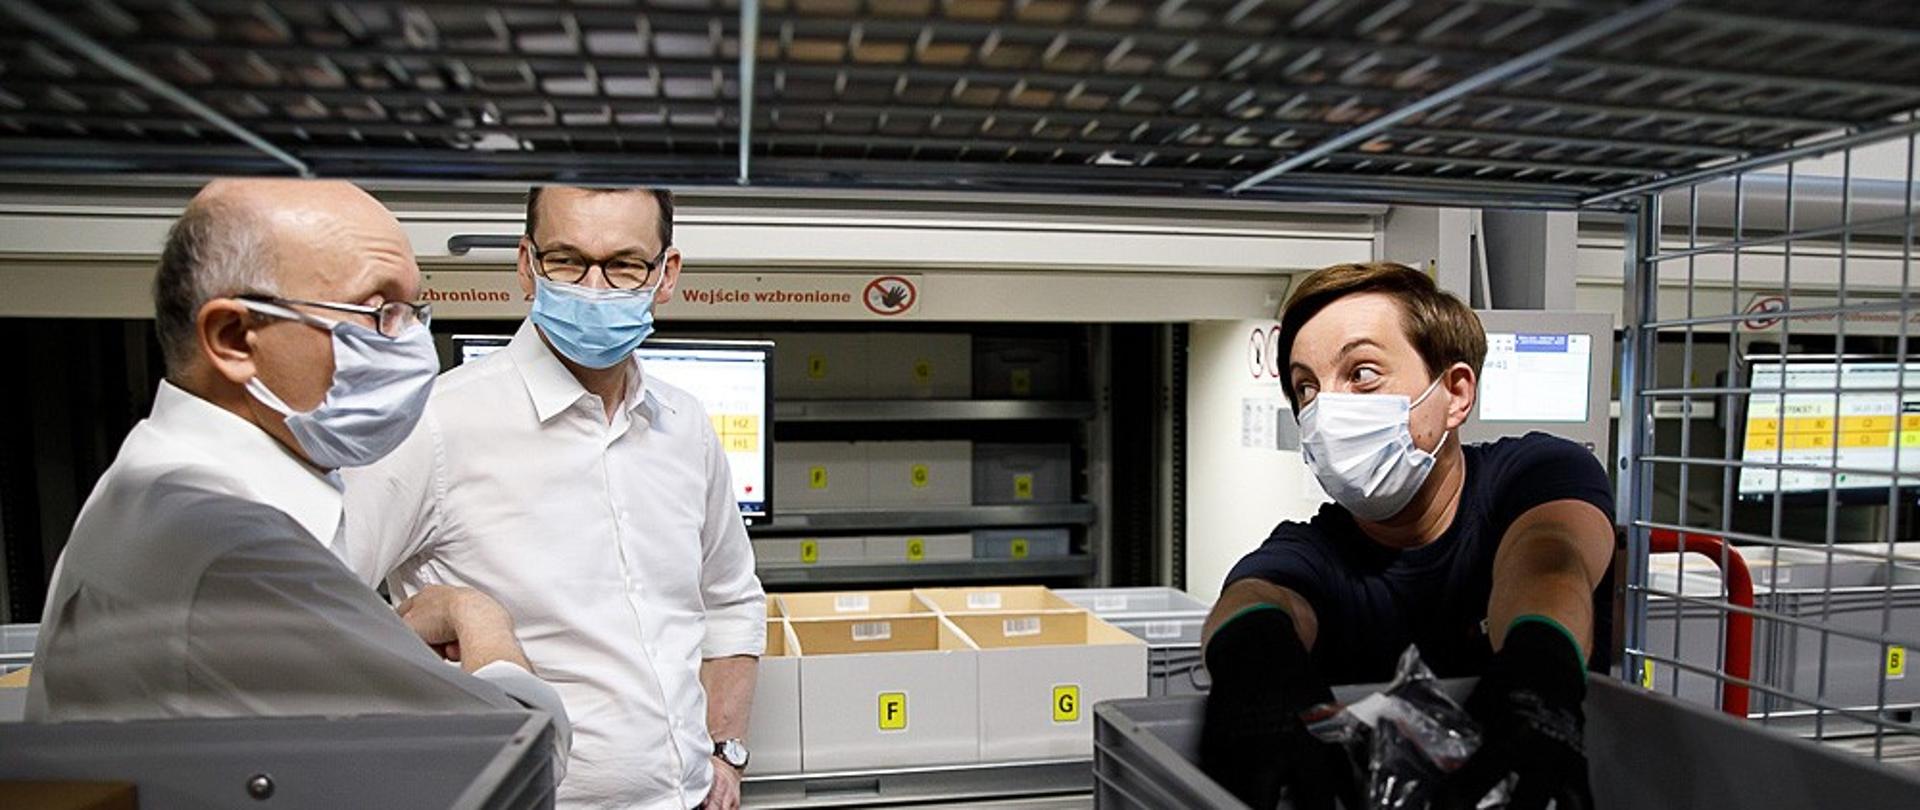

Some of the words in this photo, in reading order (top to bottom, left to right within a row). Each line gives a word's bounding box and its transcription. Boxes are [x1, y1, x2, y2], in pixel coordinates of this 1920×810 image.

[416, 288, 510, 302] zbronione
[682, 288, 749, 304] Wejście
[754, 289, 850, 303] wzbronione
[915, 469, 925, 482] G
[804, 544, 813, 556] F
[910, 543, 921, 556] G
[1014, 543, 1025, 554] H
[1891, 653, 1900, 668] B
[1058, 694, 1073, 713] G
[887, 702, 898, 720] F
